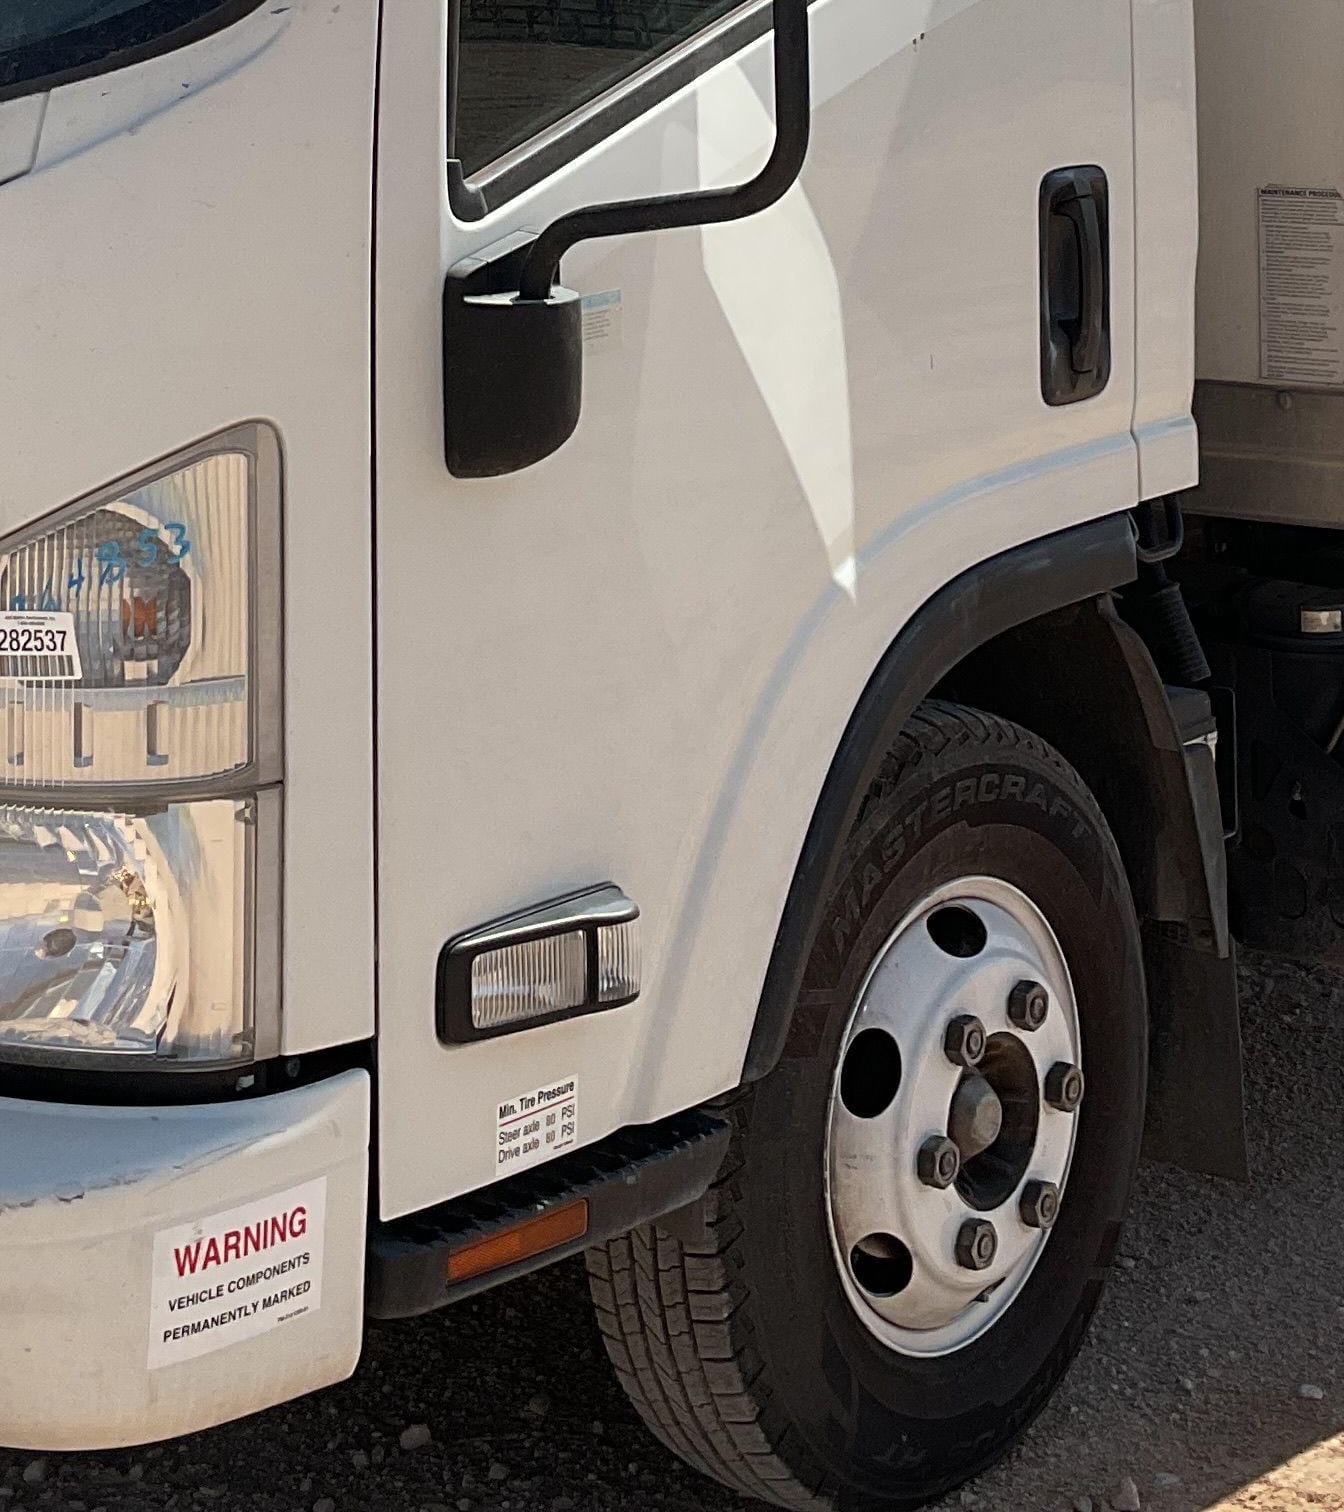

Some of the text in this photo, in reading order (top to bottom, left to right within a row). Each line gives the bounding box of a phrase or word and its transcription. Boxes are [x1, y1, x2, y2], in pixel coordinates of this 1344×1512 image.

[832, 772, 1092, 957] MASTERCRAFT
[498, 1080, 575, 1120] Min. Tire Pressure
[498, 1127, 522, 1146] Steer
[522, 1119, 540, 1137] axle
[561, 1103, 576, 1121] PSI
[498, 1146, 521, 1164] Drive
[522, 1136, 540, 1154] axle
[561, 1120, 576, 1139] PSI
[173, 1206, 307, 1278] WARNING
[162, 1301, 260, 1343] PERMANENTLY
[261, 1279, 311, 1311] MARKED
[168, 1251, 311, 1313] VEHICLE COMPONENTS
